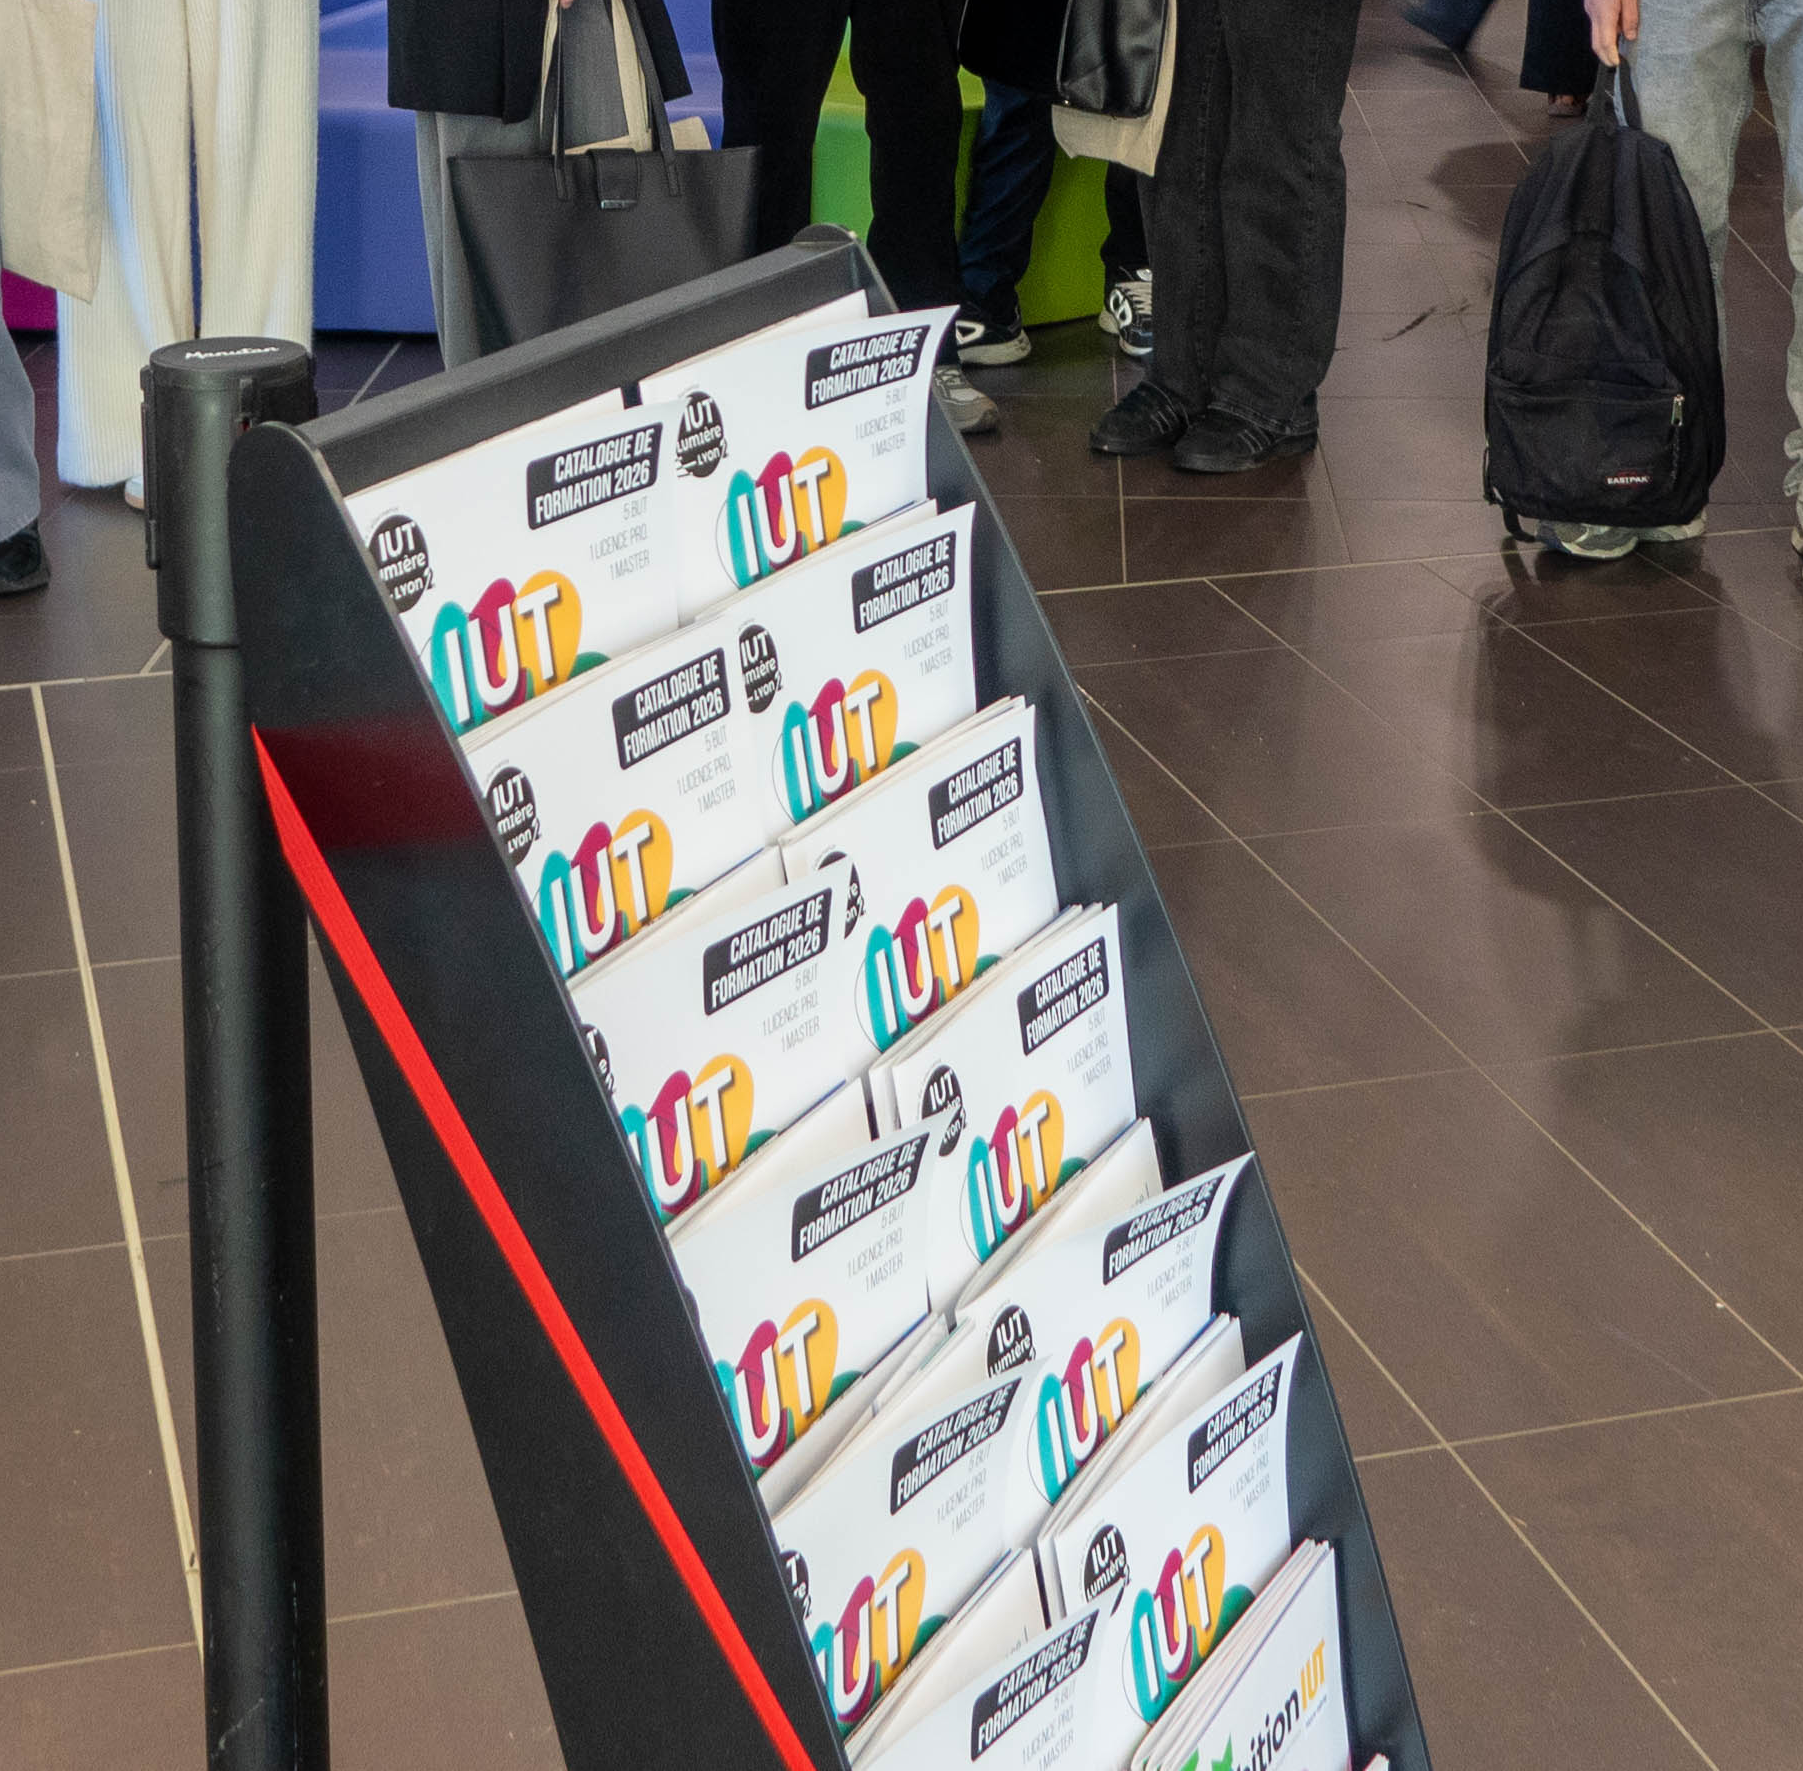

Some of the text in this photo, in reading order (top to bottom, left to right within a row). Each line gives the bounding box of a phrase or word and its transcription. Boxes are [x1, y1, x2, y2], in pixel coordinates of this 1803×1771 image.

[811, 354, 914, 405] FORMATION 2026
[830, 328, 923, 370] CATALOGUE DE
[677, 424, 723, 452] Lumière
[684, 398, 716, 432] IUT
[555, 429, 655, 483] CATALOGUE DE
[697, 448, 719, 466] Lyon
[1607, 474, 1649, 485] EASTPAK
[535, 461, 650, 523] FORMATION 2026
[631, 497, 648, 518] BUT
[737, 458, 829, 578] IUT
[378, 522, 417, 562] IUT
[379, 551, 426, 581] mière
[596, 532, 628, 559] LICENCE
[616, 550, 650, 579] MASTER
[873, 537, 951, 590] CATALOGUE DE
[394, 578, 424, 600] Lyon
[859, 566, 950, 628] FORMATION 2026
[445, 582, 560, 725] IUT
[740, 631, 770, 668] IUT
[744, 659, 776, 684] mière
[634, 655, 719, 720] CATALOGUE DE
[623, 688, 723, 763] FORMATION 2026
[712, 724, 728, 749] BUT
[791, 680, 880, 810] IUT
[493, 772, 526, 816] IUT
[683, 766, 712, 794] LICENCE
[704, 779, 736, 811] MASTER
[948, 742, 1017, 804] CATALOGUE DE
[497, 801, 534, 834] mière
[937, 773, 1018, 844] FORMATION 2026
[550, 820, 651, 973] IUT
[730, 895, 824, 965] CATALOGUE DE
[711, 926, 821, 1009] FORMATION 2026
[875, 895, 961, 1035] IUT
[1035, 943, 1101, 1009] CATALOGUE DE
[1026, 973, 1104, 1050] FORMATION 2026
[929, 1069, 955, 1111] IUT
[820, 1140, 921, 1210] CATALOGUE DE
[975, 1101, 1048, 1247] IUT
[799, 1167, 911, 1255] FORMATION 2026
[1108, 1201, 1207, 1278] FORMATION 2026
[1128, 1178, 1217, 1239] CATALOGUE DE
[996, 1309, 1023, 1353] IUT
[735, 1310, 820, 1458] UT
[1046, 1328, 1125, 1485] IUT
[1206, 1368, 1278, 1444] CATALOGUE DE
[916, 1383, 1014, 1461] CATALOGUE DE
[1193, 1394, 1272, 1486] FORMATION 2026
[897, 1410, 1001, 1506] FORMATION 2026
[1092, 1527, 1118, 1575] IUT
[1138, 1531, 1211, 1701] IUT
[998, 1618, 1091, 1705] CATALOGUE DE
[978, 1644, 1082, 1753] FORMATION 2026
[1236, 1688, 1299, 1771] ition
